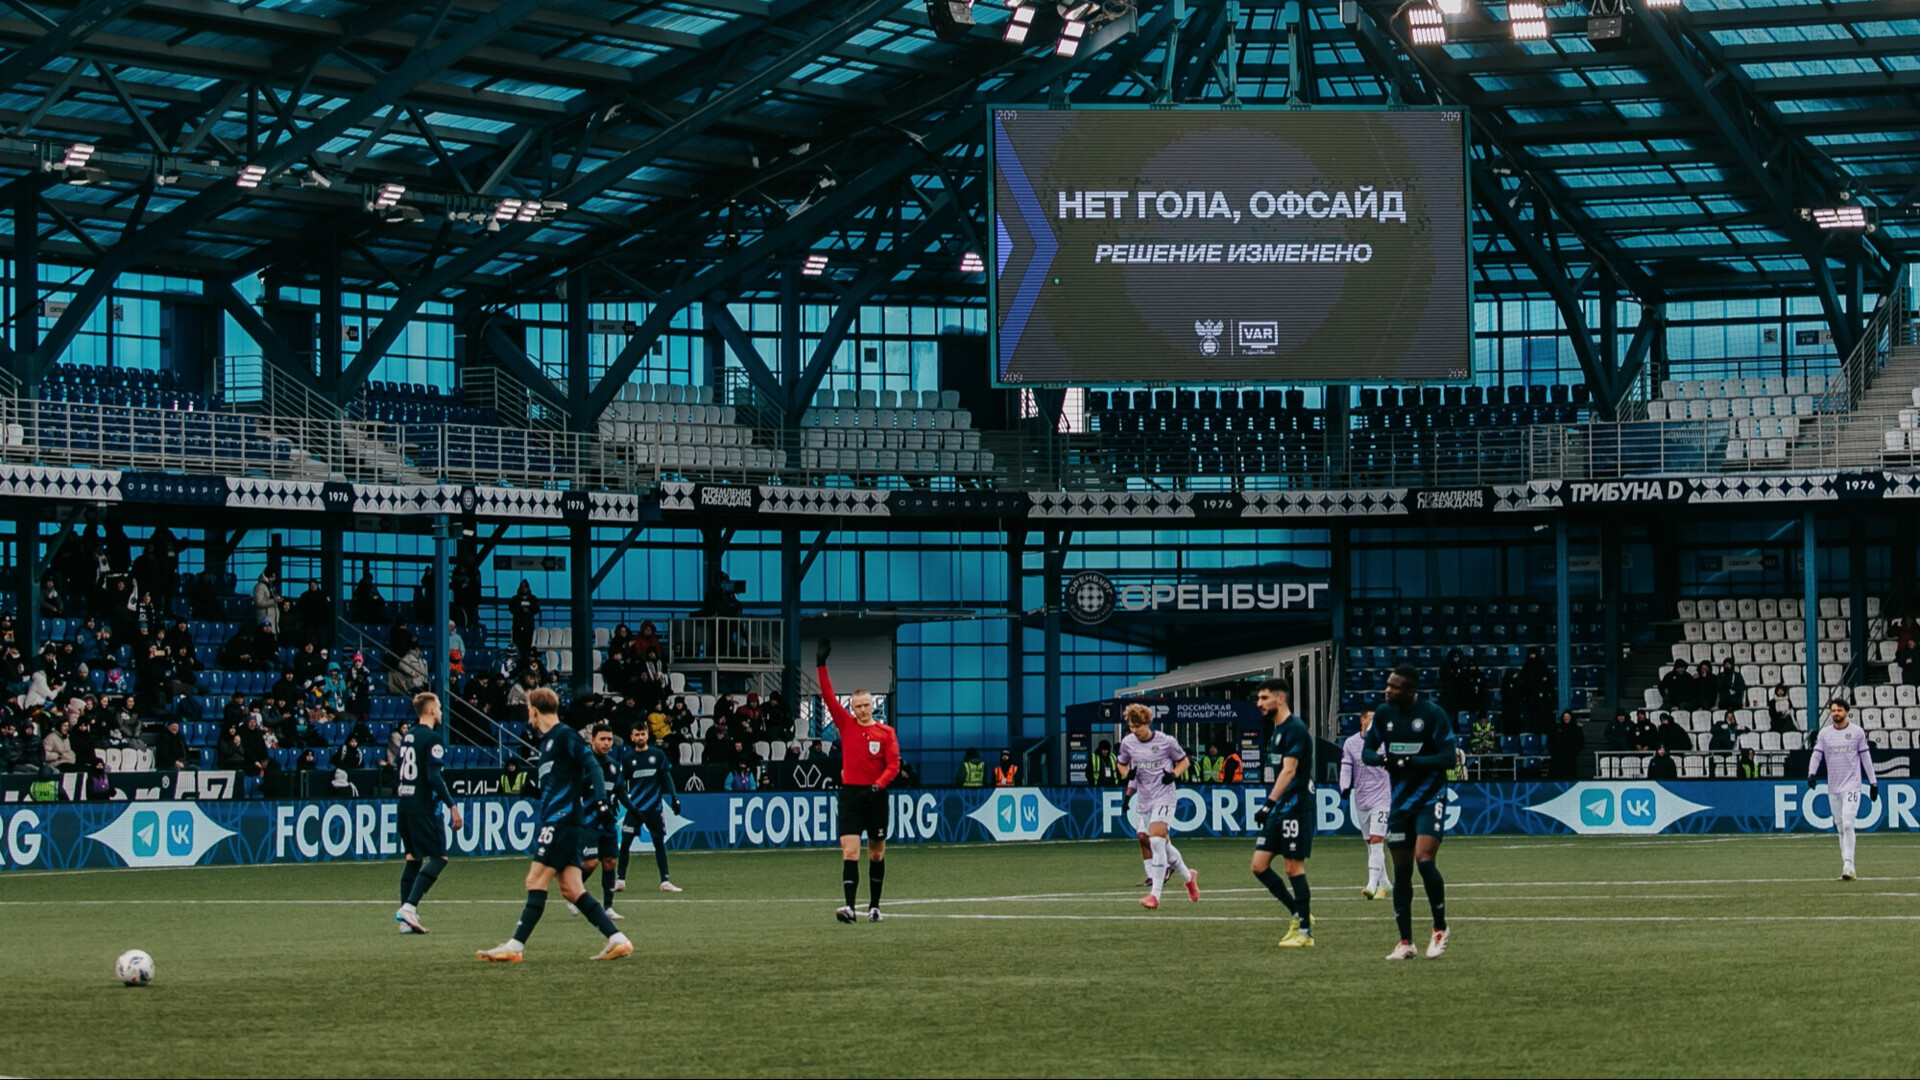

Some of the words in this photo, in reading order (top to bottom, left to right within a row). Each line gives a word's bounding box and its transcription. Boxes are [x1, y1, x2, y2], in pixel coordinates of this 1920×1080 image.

[1440, 111, 1460, 122] 209
[1058, 191, 1129, 219] НЕТ
[1137, 191, 1241, 225] ГОЛА,
[1249, 185, 1407, 223] ОФСАЙД
[1094, 243, 1223, 264] РЕШЕНИЕ
[1228, 243, 1373, 264] ИЗМЕНЕНО
[1243, 328, 1273, 339] VAR
[128, 483, 220, 495] ОРЕНБУРГ
[1570, 482, 1664, 502] ТРИБУНА
[1667, 480, 1683, 500] D
[1846, 480, 1875, 491] 1976
[328, 491, 349, 502] 1976
[566, 500, 585, 510] 1976
[899, 500, 1020, 508] ОРЕНБУРГ
[1203, 500, 1233, 509] 1976
[1069, 574, 1113, 594] ОРЕНБУРГ
[1121, 583, 1329, 610] ОРЕНБУРГ
[1177, 703, 1232, 711] РОССИЙСКАЯ
[400, 746, 418, 780] 78
[1847, 791, 1859, 803] 26
[1433, 801, 1444, 819] 6
[1377, 811, 1389, 824] 23
[276, 801, 535, 858] FCOREURG
[1282, 819, 1300, 838] 59
[0, 808, 42, 866] G
